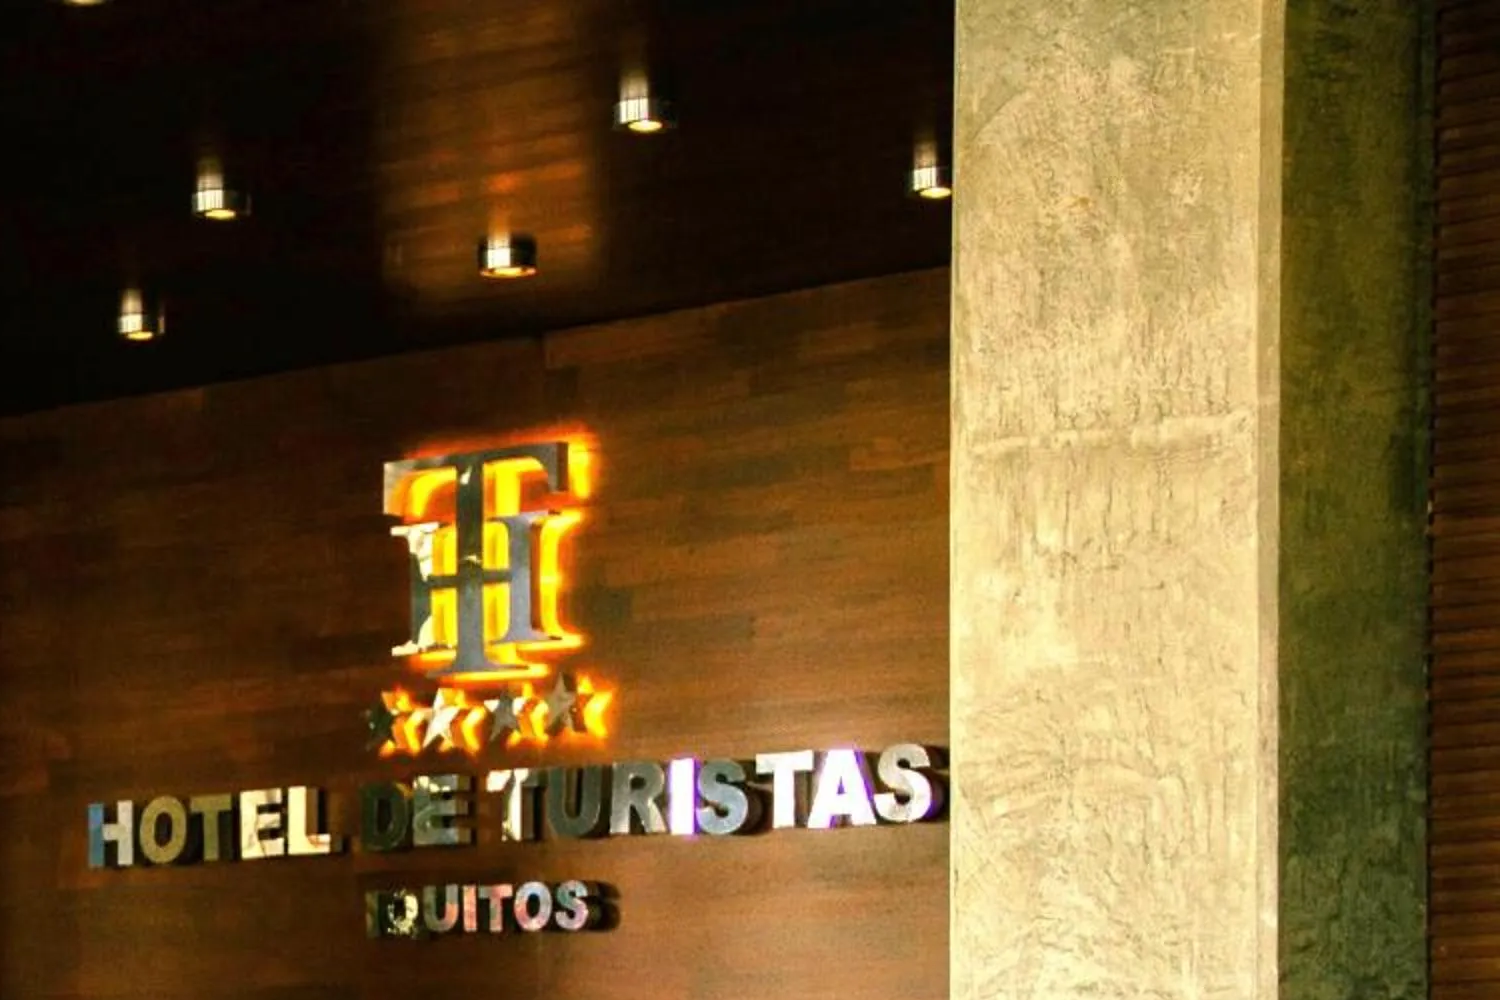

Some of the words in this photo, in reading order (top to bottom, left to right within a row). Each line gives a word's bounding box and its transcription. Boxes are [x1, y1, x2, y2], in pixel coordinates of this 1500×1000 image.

[87, 785, 332, 869] HOTEL
[361, 773, 466, 851] DE
[485, 743, 936, 842] TURISTAS
